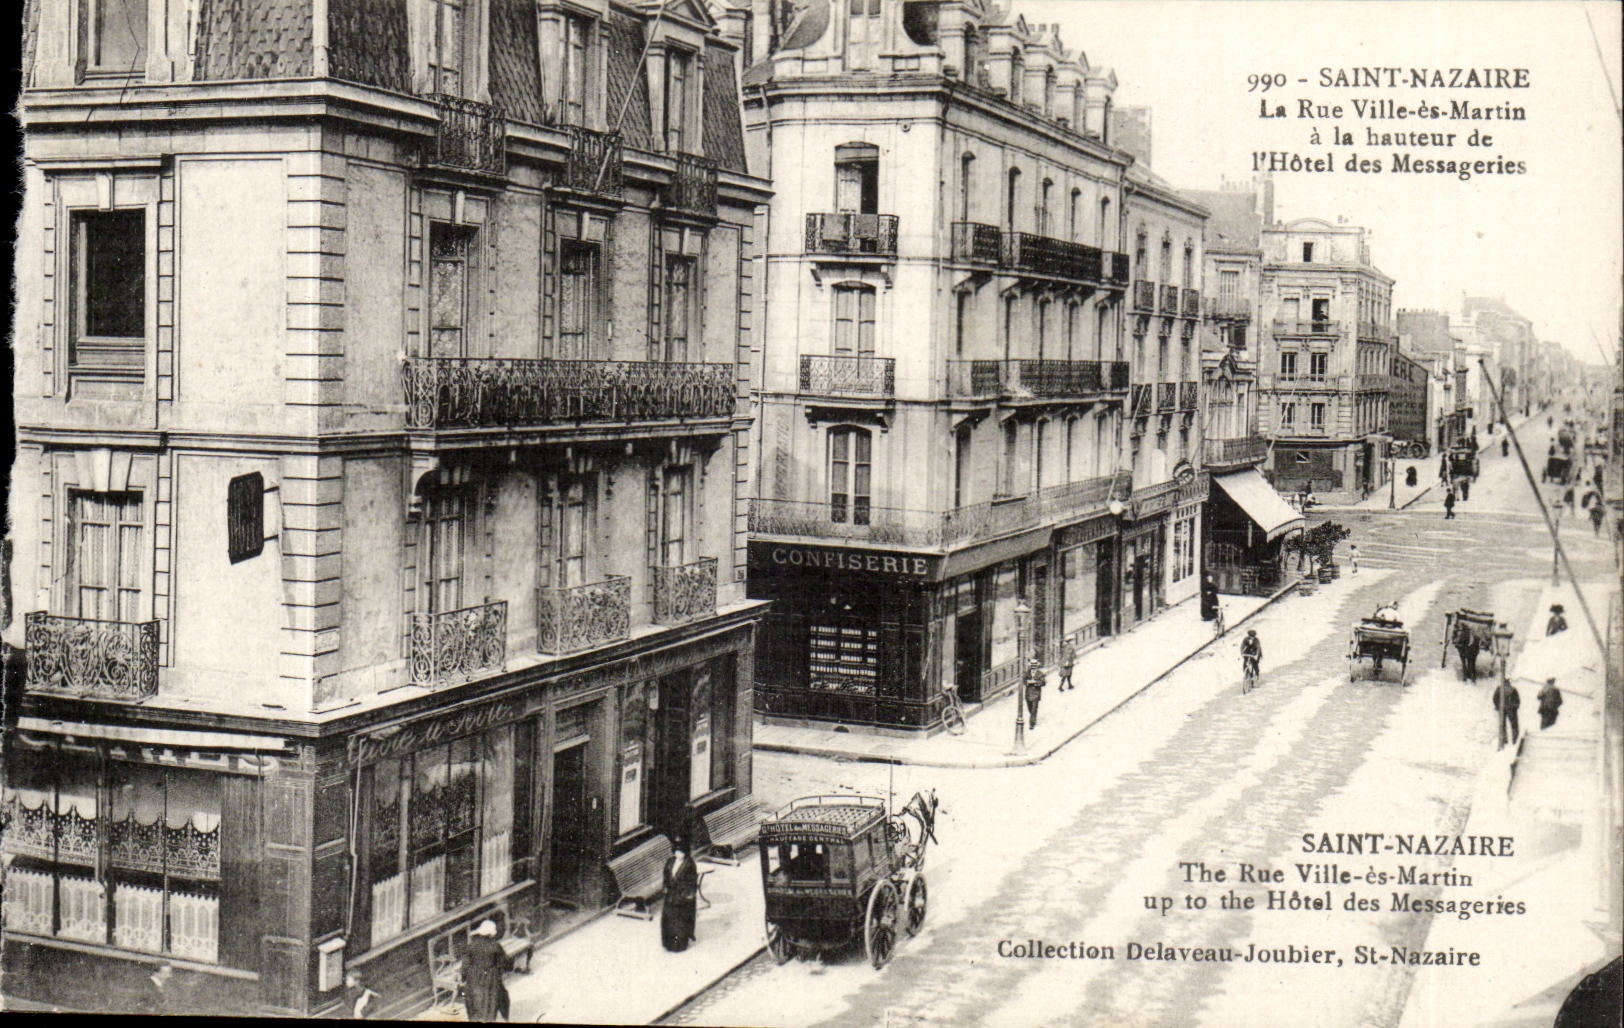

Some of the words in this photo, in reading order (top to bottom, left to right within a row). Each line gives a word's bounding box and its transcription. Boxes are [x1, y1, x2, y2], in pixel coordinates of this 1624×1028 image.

[772, 548, 928, 576] CONFISERIE
[802, 823, 847, 834] MESSAGERIES
[767, 834, 806, 842] HAUFFAGE
